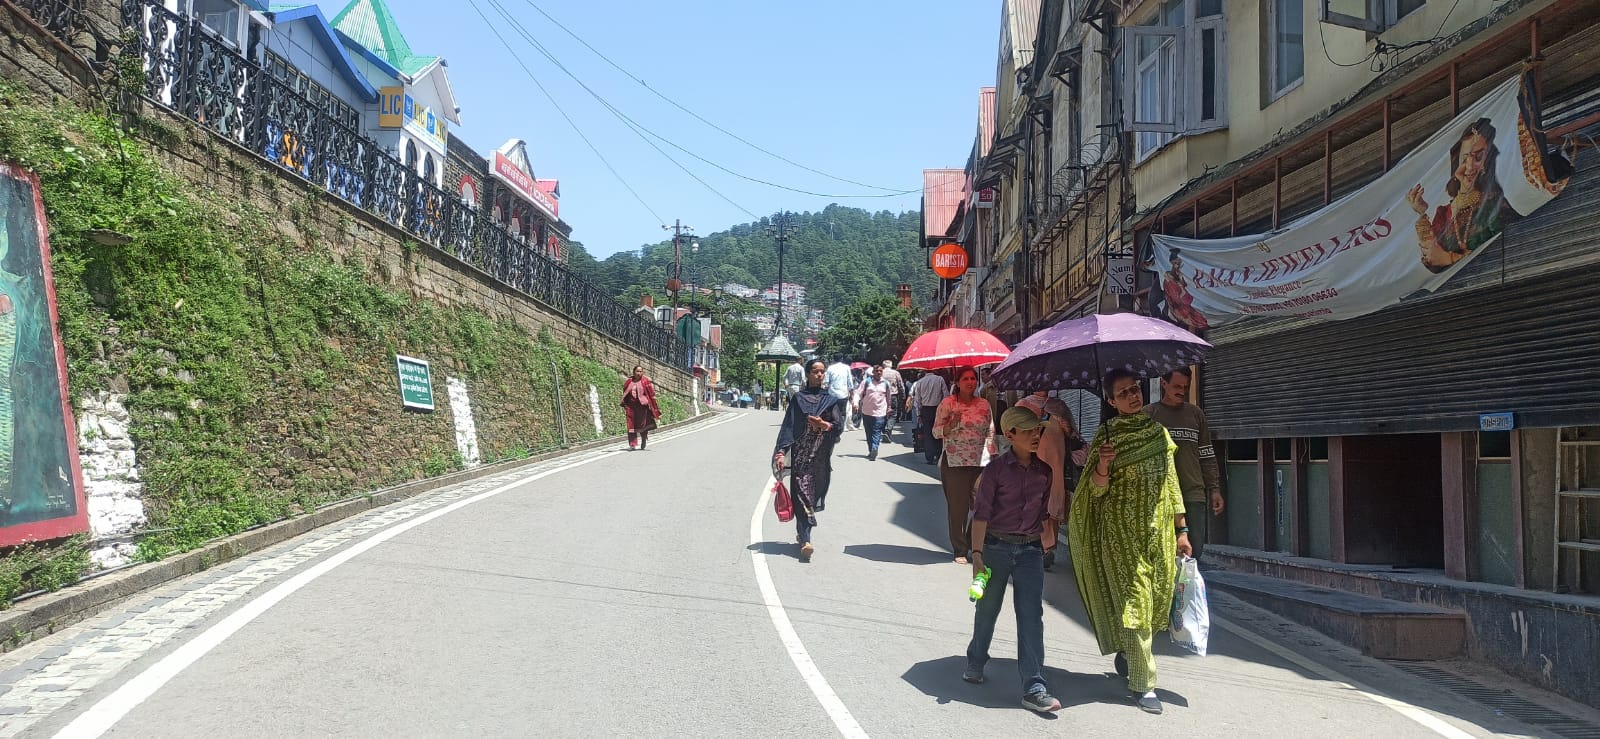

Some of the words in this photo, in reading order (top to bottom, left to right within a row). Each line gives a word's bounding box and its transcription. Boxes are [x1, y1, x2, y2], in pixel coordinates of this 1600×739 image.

[381, 94, 401, 115] LIC
[935, 253, 965, 268] BARISTA
[1268, 280, 1301, 297] Elegance
